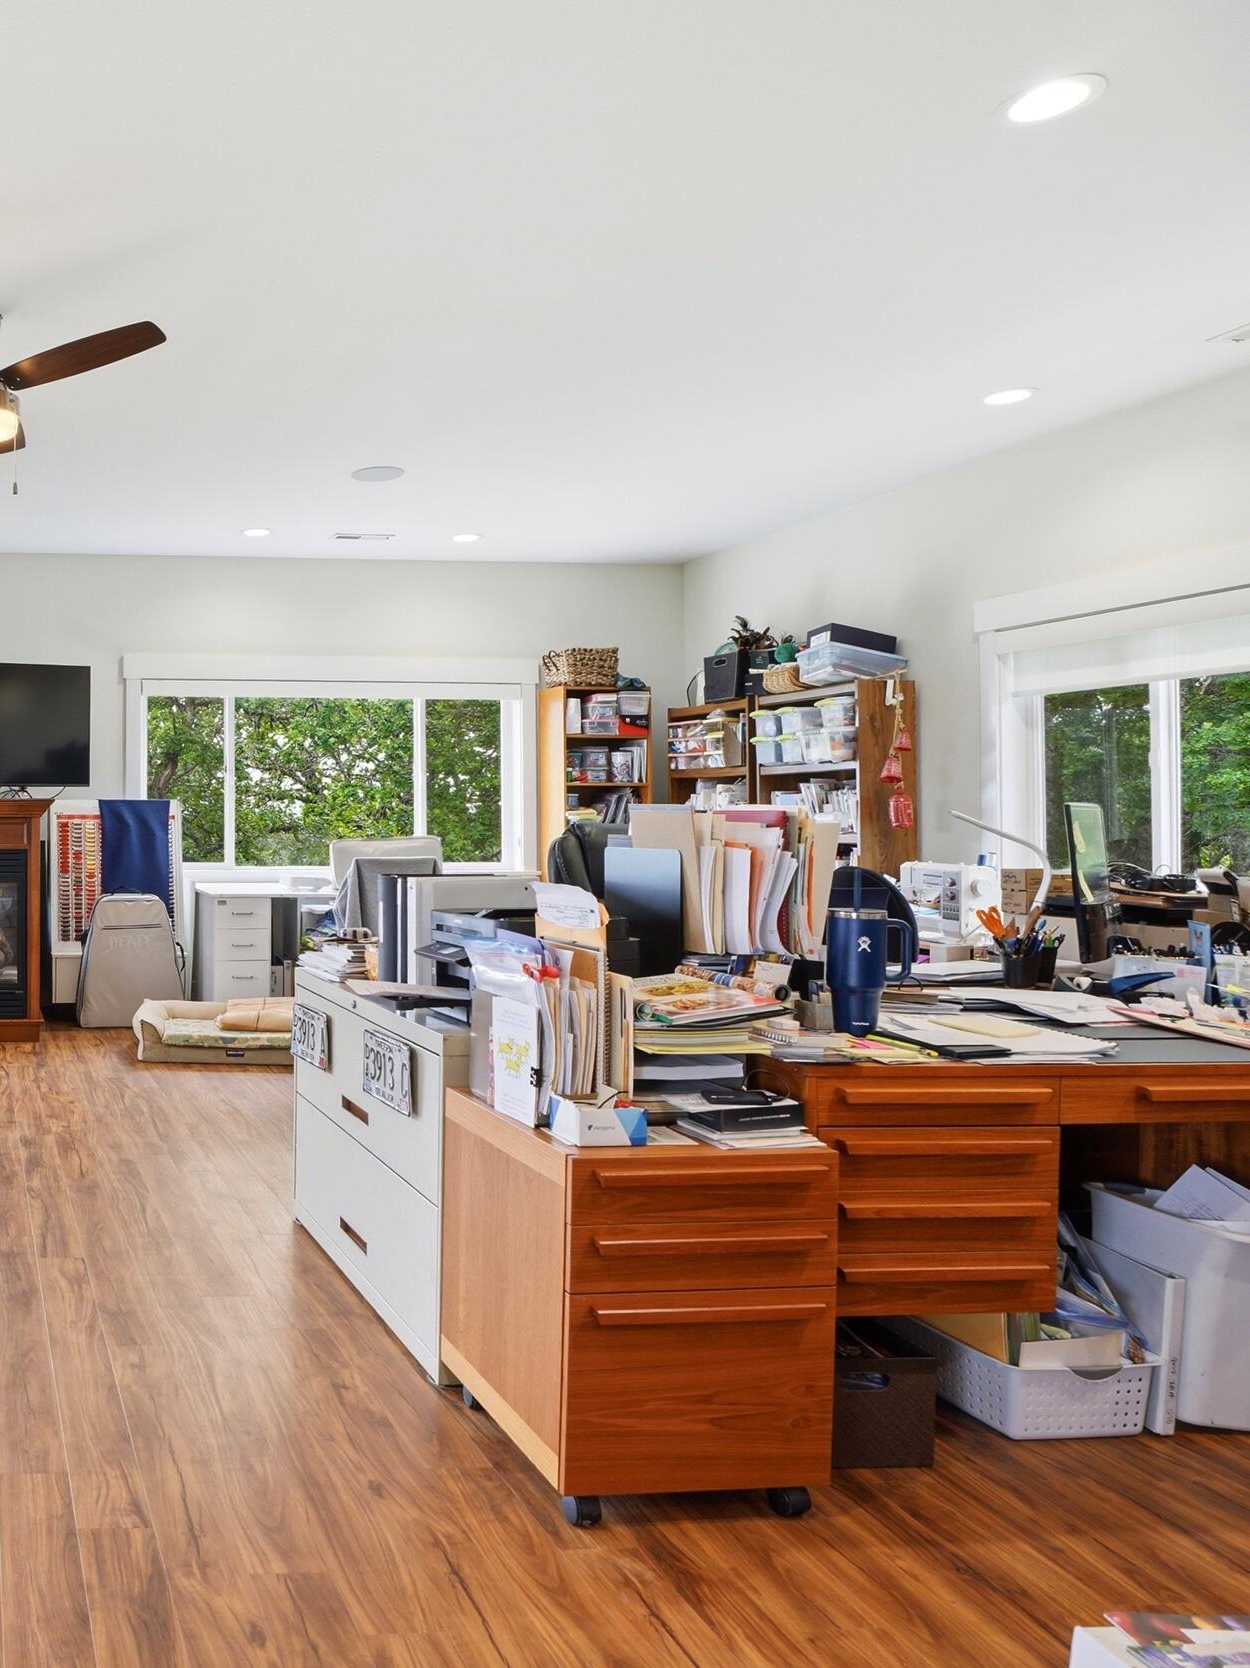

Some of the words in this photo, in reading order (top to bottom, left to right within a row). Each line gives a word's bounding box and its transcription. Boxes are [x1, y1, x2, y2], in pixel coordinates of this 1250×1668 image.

[297, 1016, 316, 1051] 3913
[370, 1048, 395, 1091] 3913
[401, 1061, 408, 1099] C
[375, 1087, 394, 1102] DEALER
